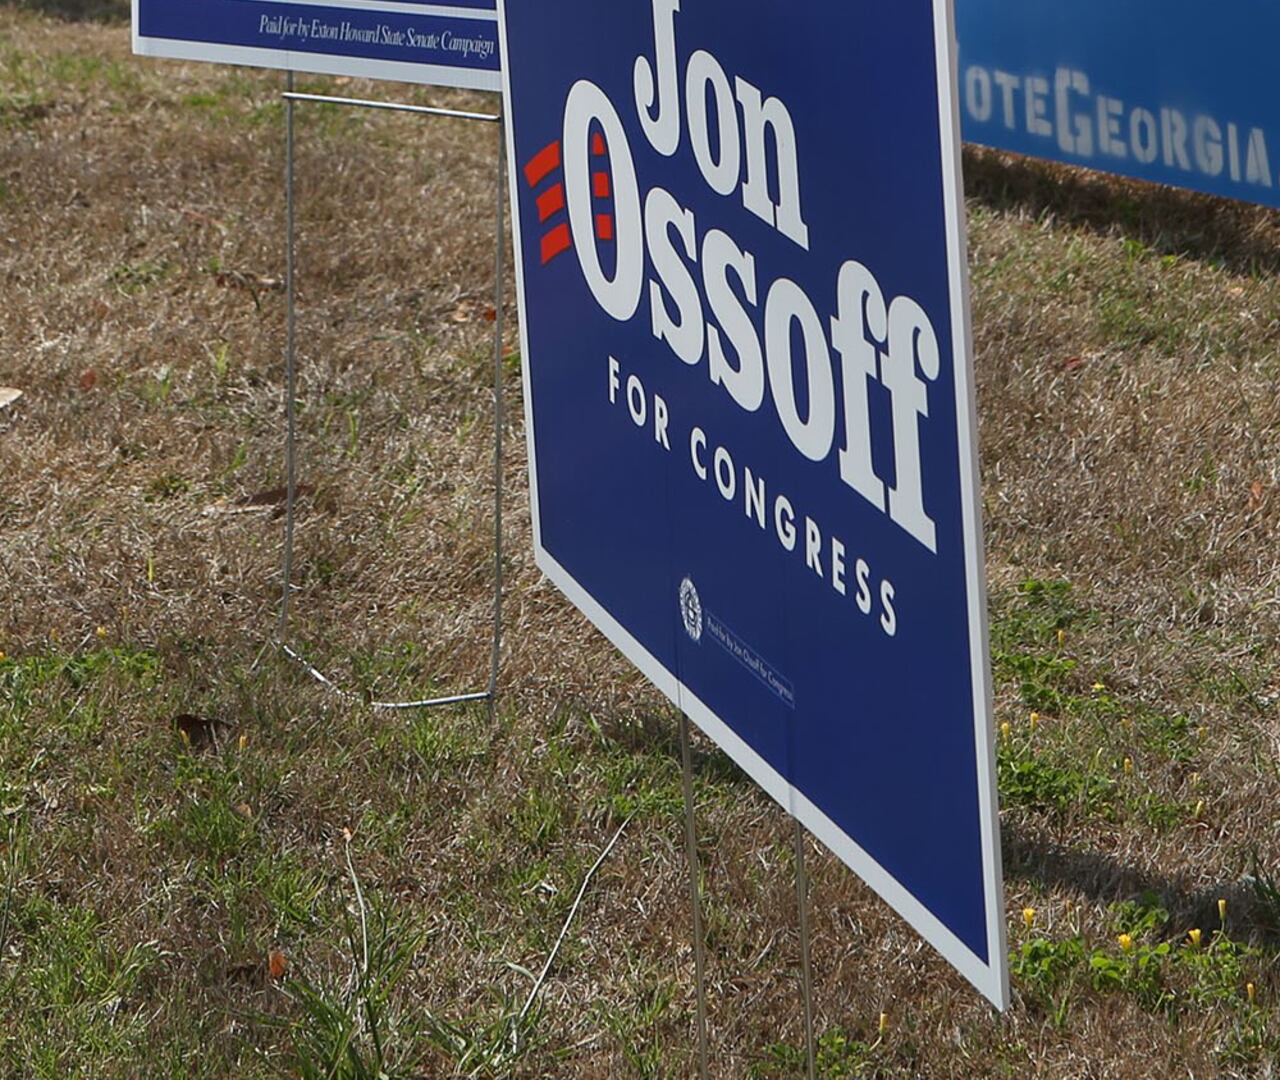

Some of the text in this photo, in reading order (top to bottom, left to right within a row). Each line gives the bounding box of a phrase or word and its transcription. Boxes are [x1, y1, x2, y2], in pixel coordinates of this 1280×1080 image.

[259, 14, 495, 58] Paid for by Exton Howard State Senate Campaign
[563, 79, 939, 555] Ossoff
[608, 355, 670, 451] FOR
[690, 426, 896, 637] CONGRESS
